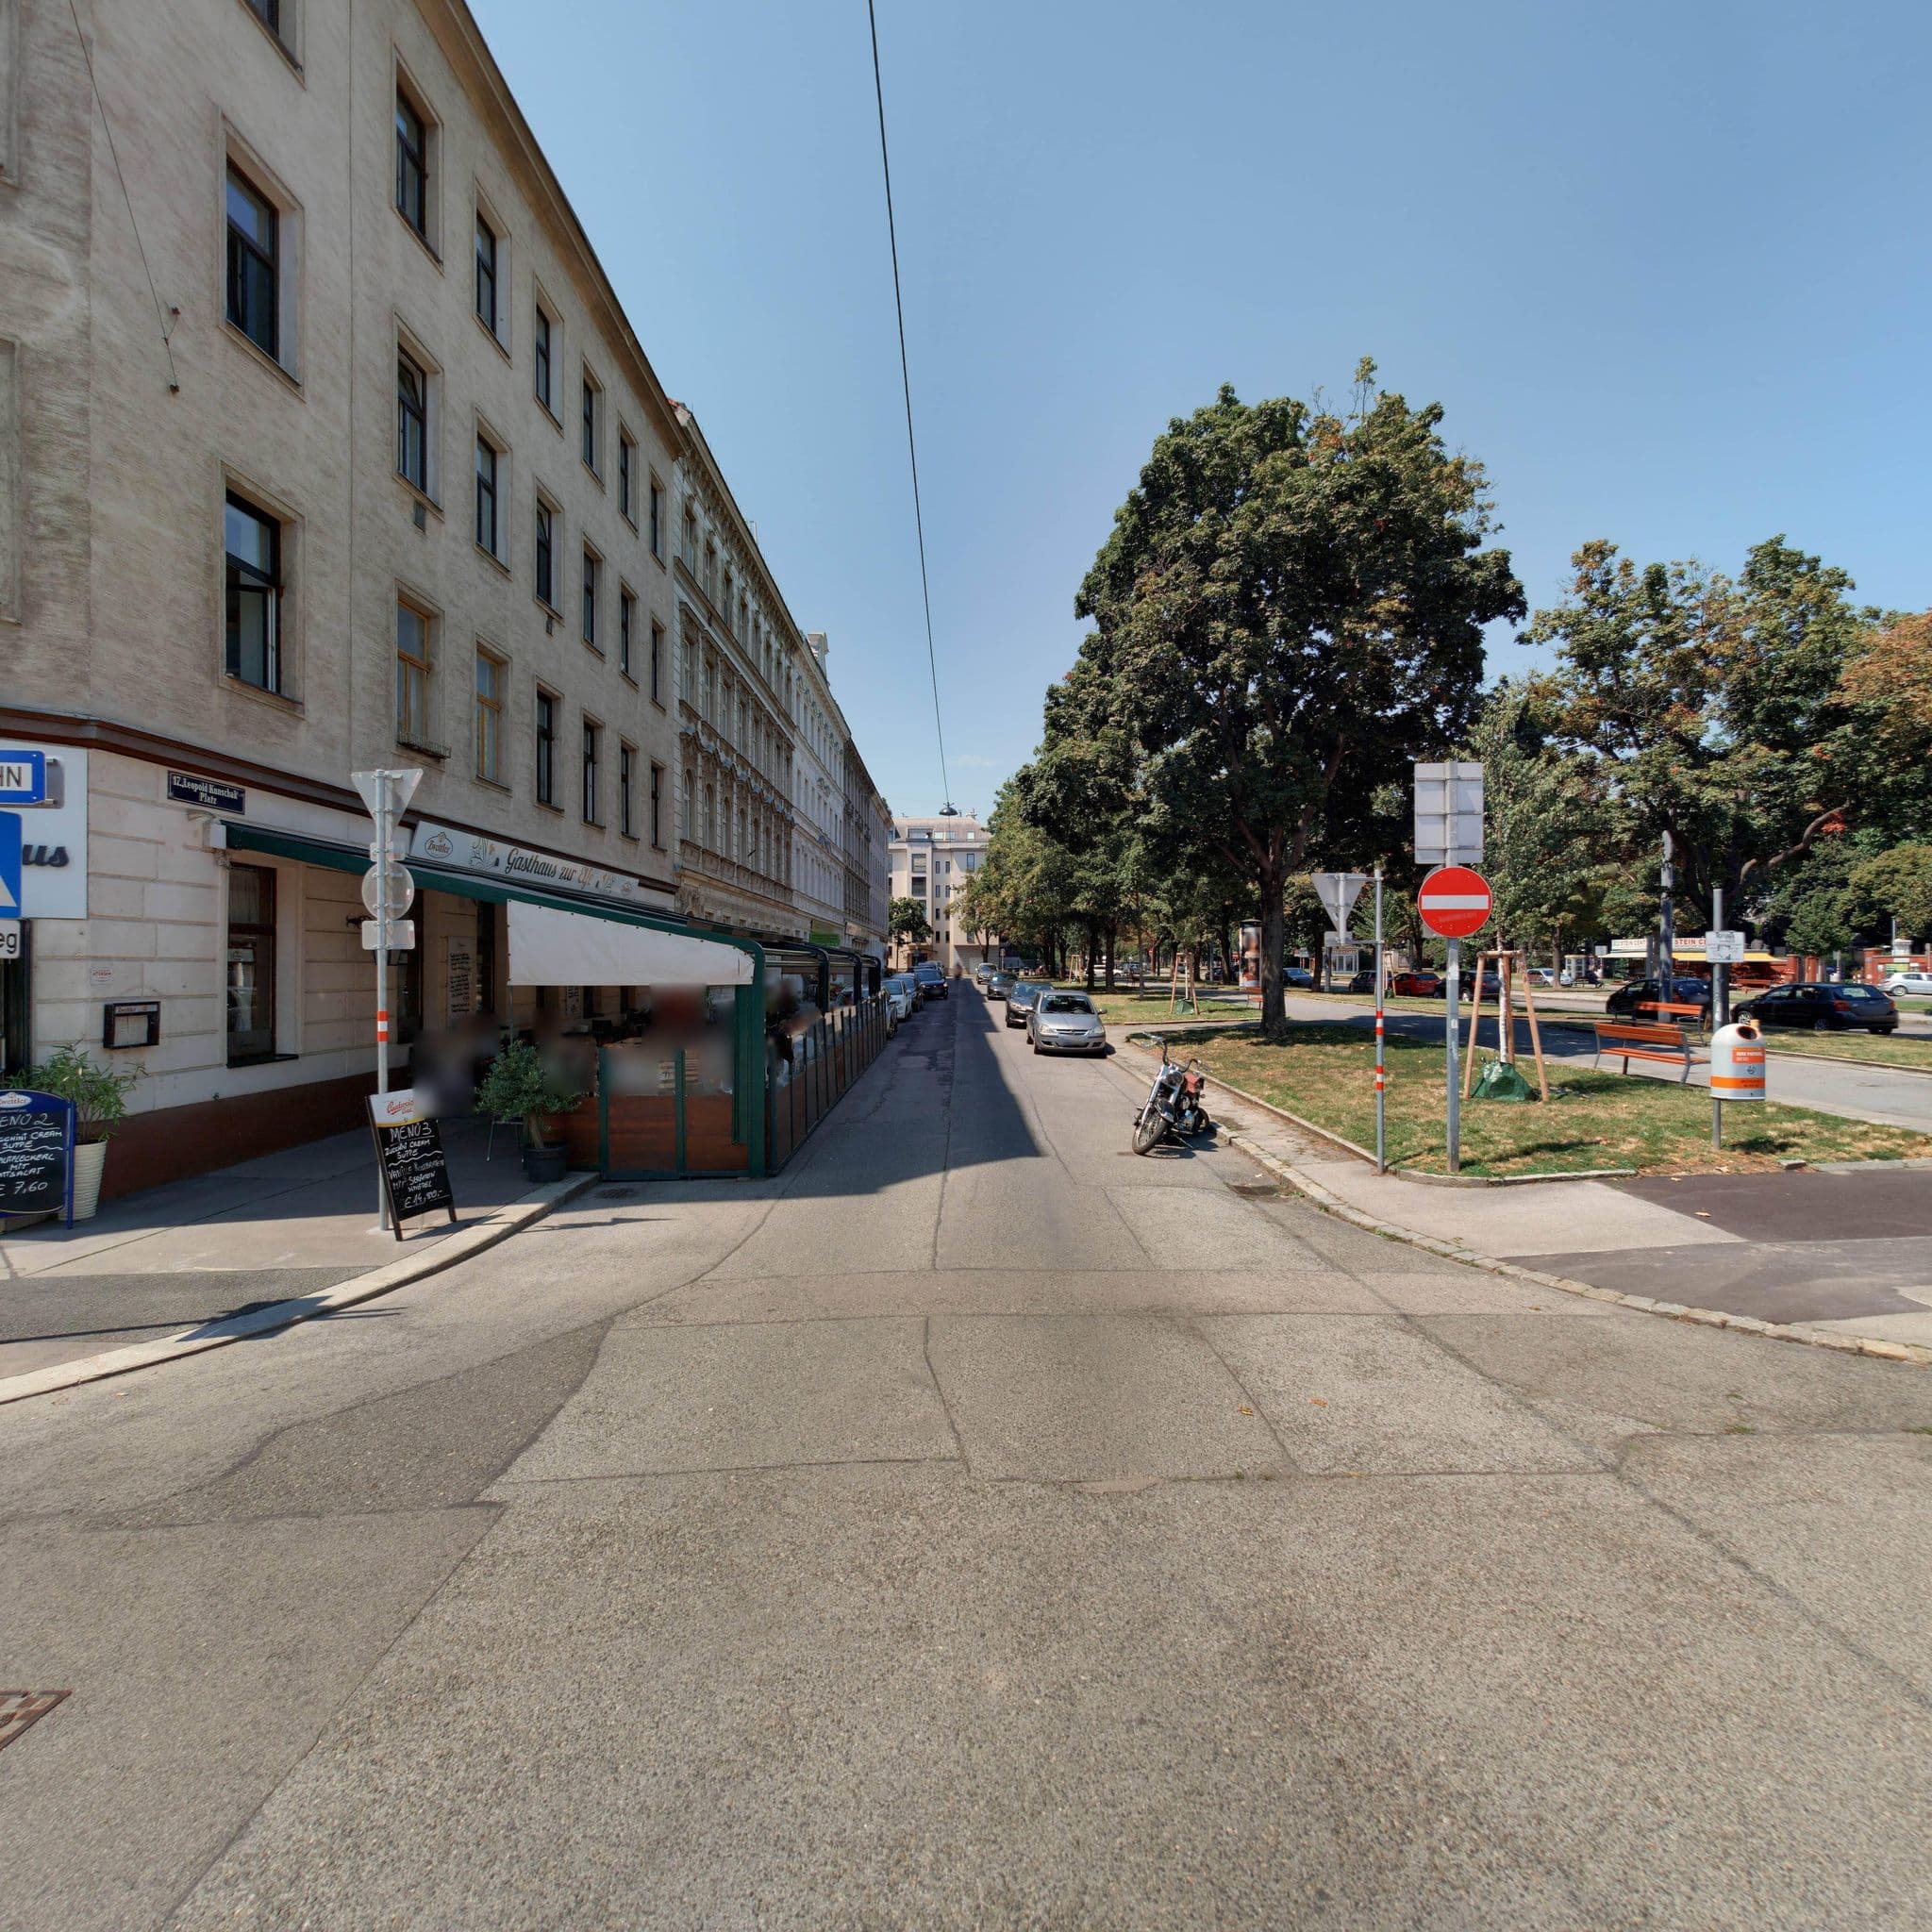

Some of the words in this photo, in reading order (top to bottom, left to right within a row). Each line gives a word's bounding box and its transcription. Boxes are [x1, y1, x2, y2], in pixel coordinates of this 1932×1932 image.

[199, 792, 217, 805] Platz
[505, 848, 558, 878] Gasthaus
[558, 866, 576, 881] zur
[33, 1113, 55, 1125] 2
[390, 1123, 422, 1142] MENÜ
[423, 1122, 432, 1136] 3
[2, 1141, 33, 1149] SUPPE
